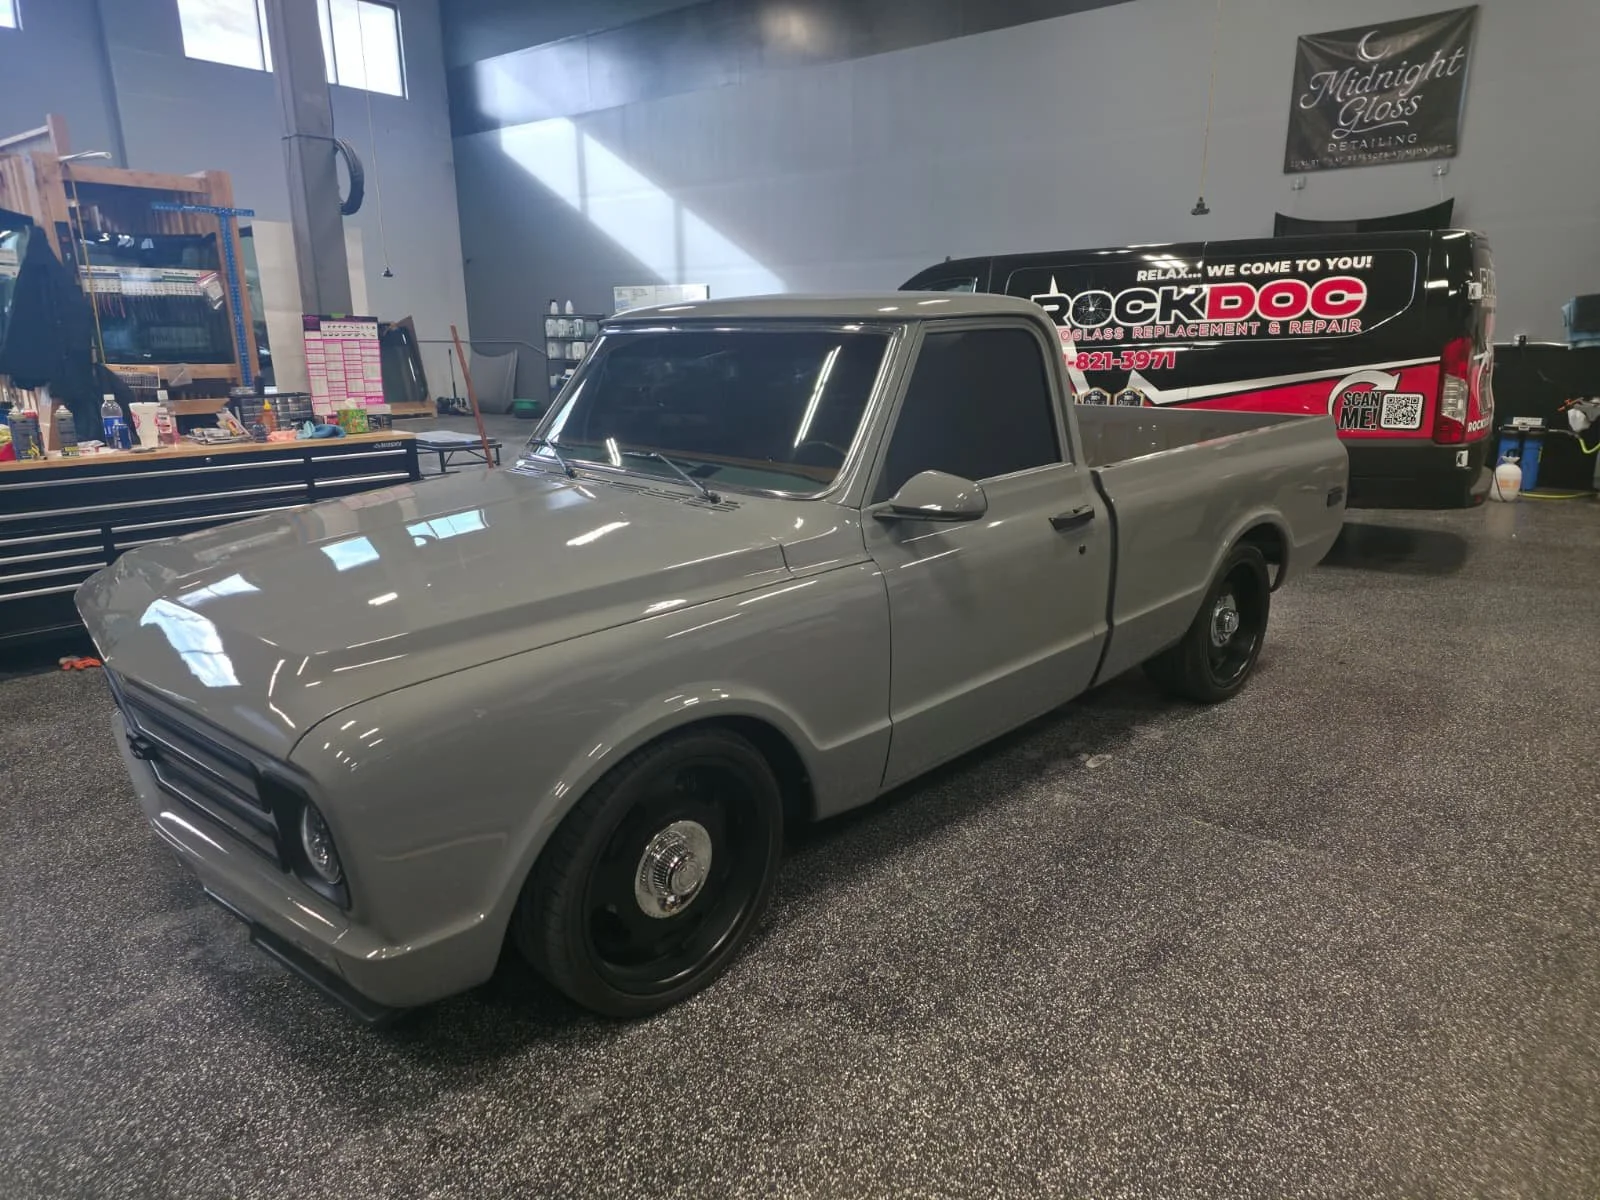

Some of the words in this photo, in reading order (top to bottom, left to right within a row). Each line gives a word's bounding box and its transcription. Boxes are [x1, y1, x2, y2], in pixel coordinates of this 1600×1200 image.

[1300, 46, 1465, 109] Midnight
[1332, 94, 1423, 139] Gloss
[1327, 133, 1417, 152] DETAILING
[1136, 268, 1202, 282] RELAX...
[1207, 265, 1235, 277] WE
[1240, 260, 1291, 275] COME
[1296, 258, 1318, 272] TO
[1326, 255, 1373, 270] YOU!
[1057, 326, 1125, 342] OGLASS
[1132, 321, 1260, 340] REPLACEMENT
[1268, 322, 1280, 335] &
[1289, 318, 1362, 335] REPAIR
[1343, 391, 1382, 407] SCAN
[1339, 406, 1380, 430] ME!
